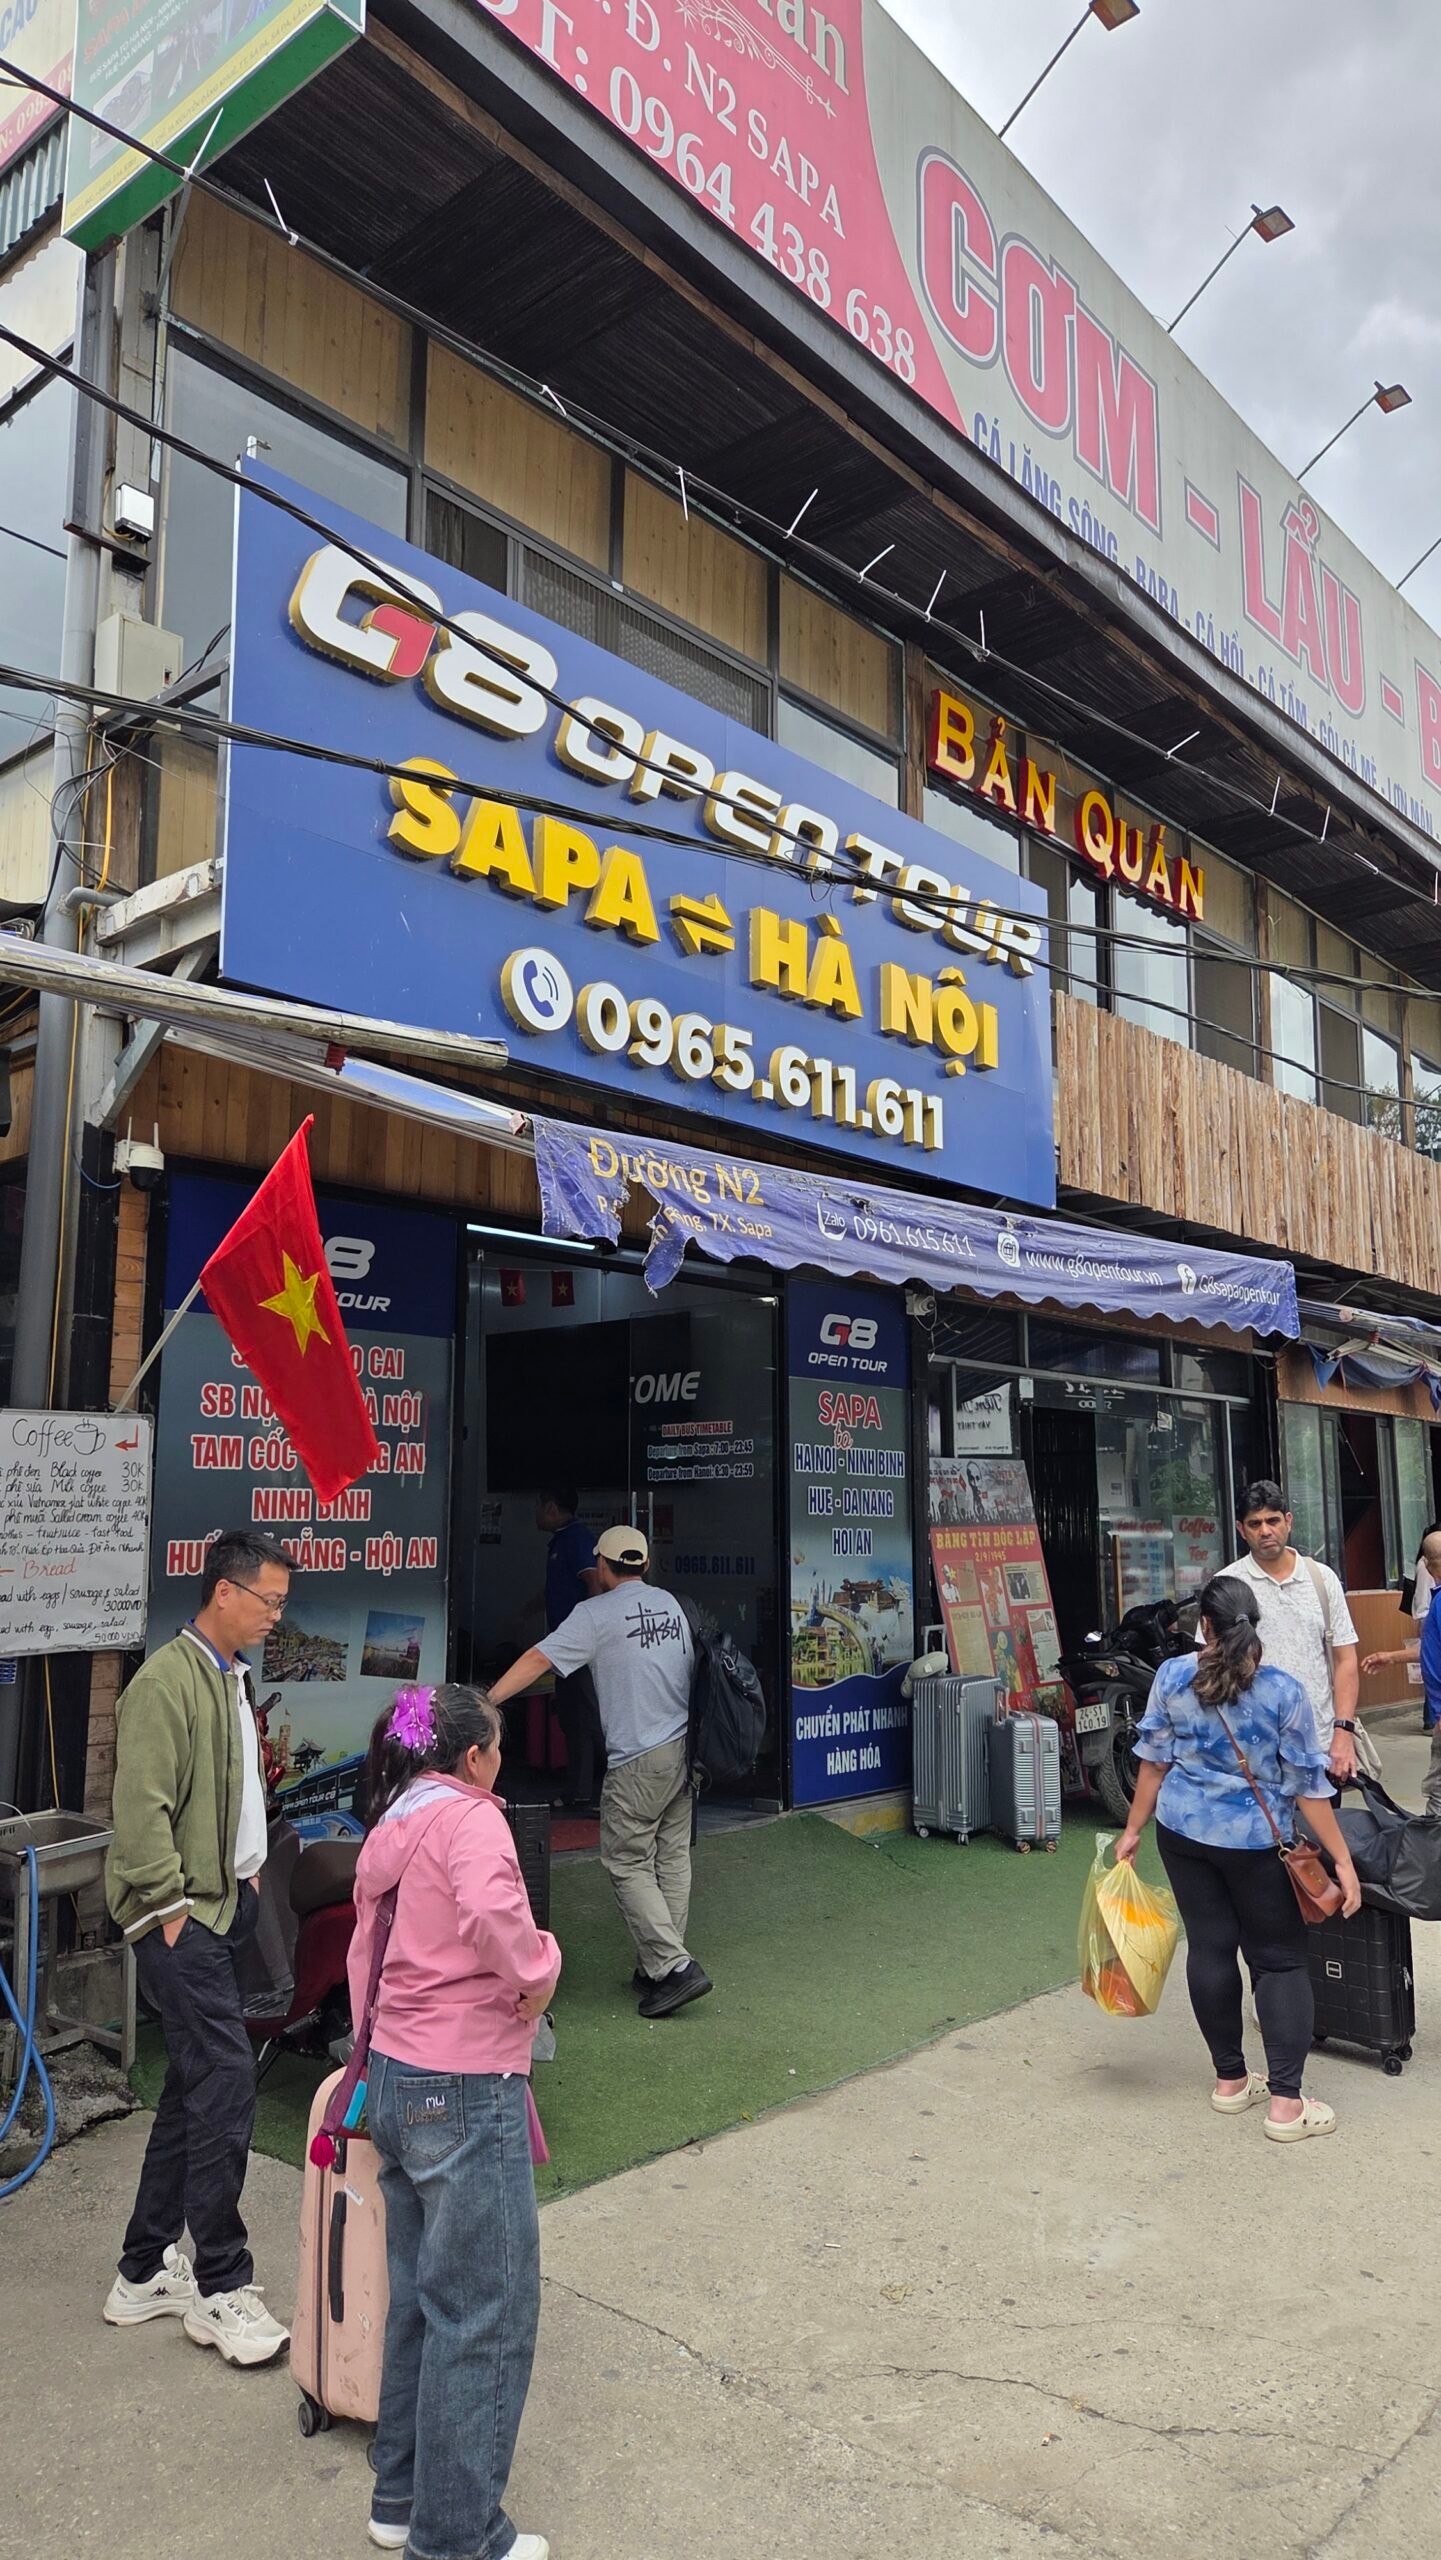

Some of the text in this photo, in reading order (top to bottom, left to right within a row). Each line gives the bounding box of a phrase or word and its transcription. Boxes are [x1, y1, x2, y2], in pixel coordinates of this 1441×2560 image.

[757, 0, 849, 95] an
[684, 41, 846, 240] N2 SAPA
[482, 0, 916, 385] T: 0964 438 638
[915, 144, 1163, 542] CƠM
[1236, 469, 1366, 720] LẨU
[974, 411, 1001, 467] CÁ
[1068, 496, 1118, 565] SÔNG
[288, 543, 558, 740] G8
[929, 688, 1206, 922] BẢN QUÁN
[554, 696, 1042, 978] OPEN TOUR
[387, 756, 999, 1078] SAPA HÀ NỘI
[577, 981, 944, 1152] 0965.611.611
[588, 1137, 765, 1206] Đường N2
[737, 1217, 773, 1239] Sapa
[824, 1210, 976, 1258] Zalo 0961.615.611
[1026, 1252, 1164, 1287] www.g8opentour.vn
[334, 1291, 392, 1312] OUR
[1200, 1275, 1281, 1306] G8sapaopentour
[820, 1313, 878, 1350] G8
[368, 1346, 405, 1379] CAI
[808, 1352, 888, 1373] OPEN TOUR
[630, 1371, 701, 1405] OME
[201, 1382, 236, 1418] SB
[383, 1390, 422, 1433] NỘI
[818, 1391, 882, 1430] SAPA
[12, 1418, 74, 1458] Coffee
[681, 1421, 696, 1437] BUS
[191, 1434, 243, 1470] TAM
[249, 1427, 297, 1471] CỐC
[394, 1442, 426, 1474] AN
[795, 1443, 811, 1472] HA
[814, 1445, 836, 1474] NOI
[847, 1448, 875, 1476] NINH
[878, 1450, 906, 1478] BINH
[734, 1462, 754, 1478] 23:59
[252, 1487, 312, 1521] NINH
[808, 1486, 894, 1517] HUE DA NANG
[832, 1528, 872, 1556] HOI AN
[1179, 1518, 1216, 1538] Coffee
[23, 1557, 77, 1580] Bread
[365, 1531, 402, 1577] HỘI
[406, 1536, 437, 1569] AN
[675, 1555, 755, 1576] 0965.611.611
[796, 1704, 908, 1741] CHUYỂN PHÁT NHANH
[1078, 1715, 1107, 1732] 140.19
[1080, 1705, 1103, 1720] 24-S1
[827, 1742, 881, 1776] HÀNG HÓA
